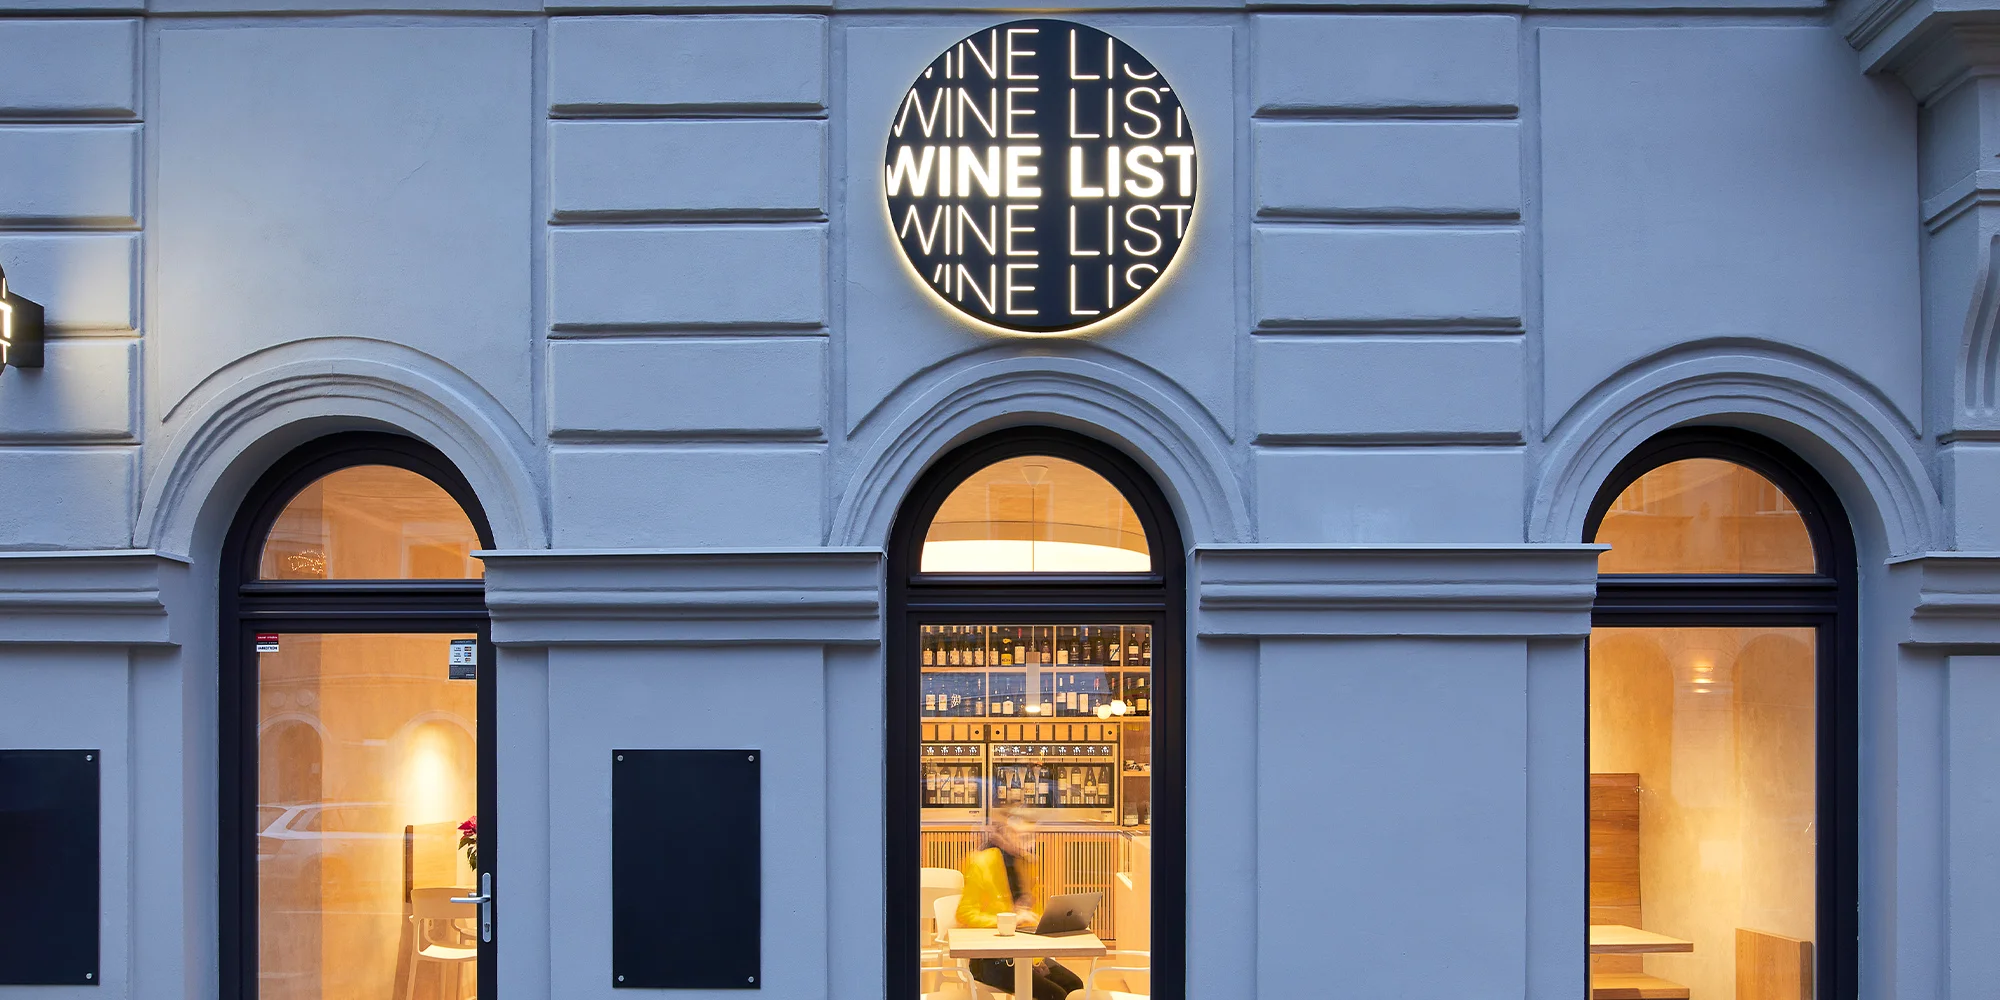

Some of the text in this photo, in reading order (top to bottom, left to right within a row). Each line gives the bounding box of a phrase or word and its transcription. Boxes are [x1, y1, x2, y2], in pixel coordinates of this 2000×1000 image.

[895, 88, 1039, 138] WINE
[887, 145, 1194, 199] WINE LIST
[901, 204, 1191, 256] WINE LIST
[934, 264, 1038, 314] INE
